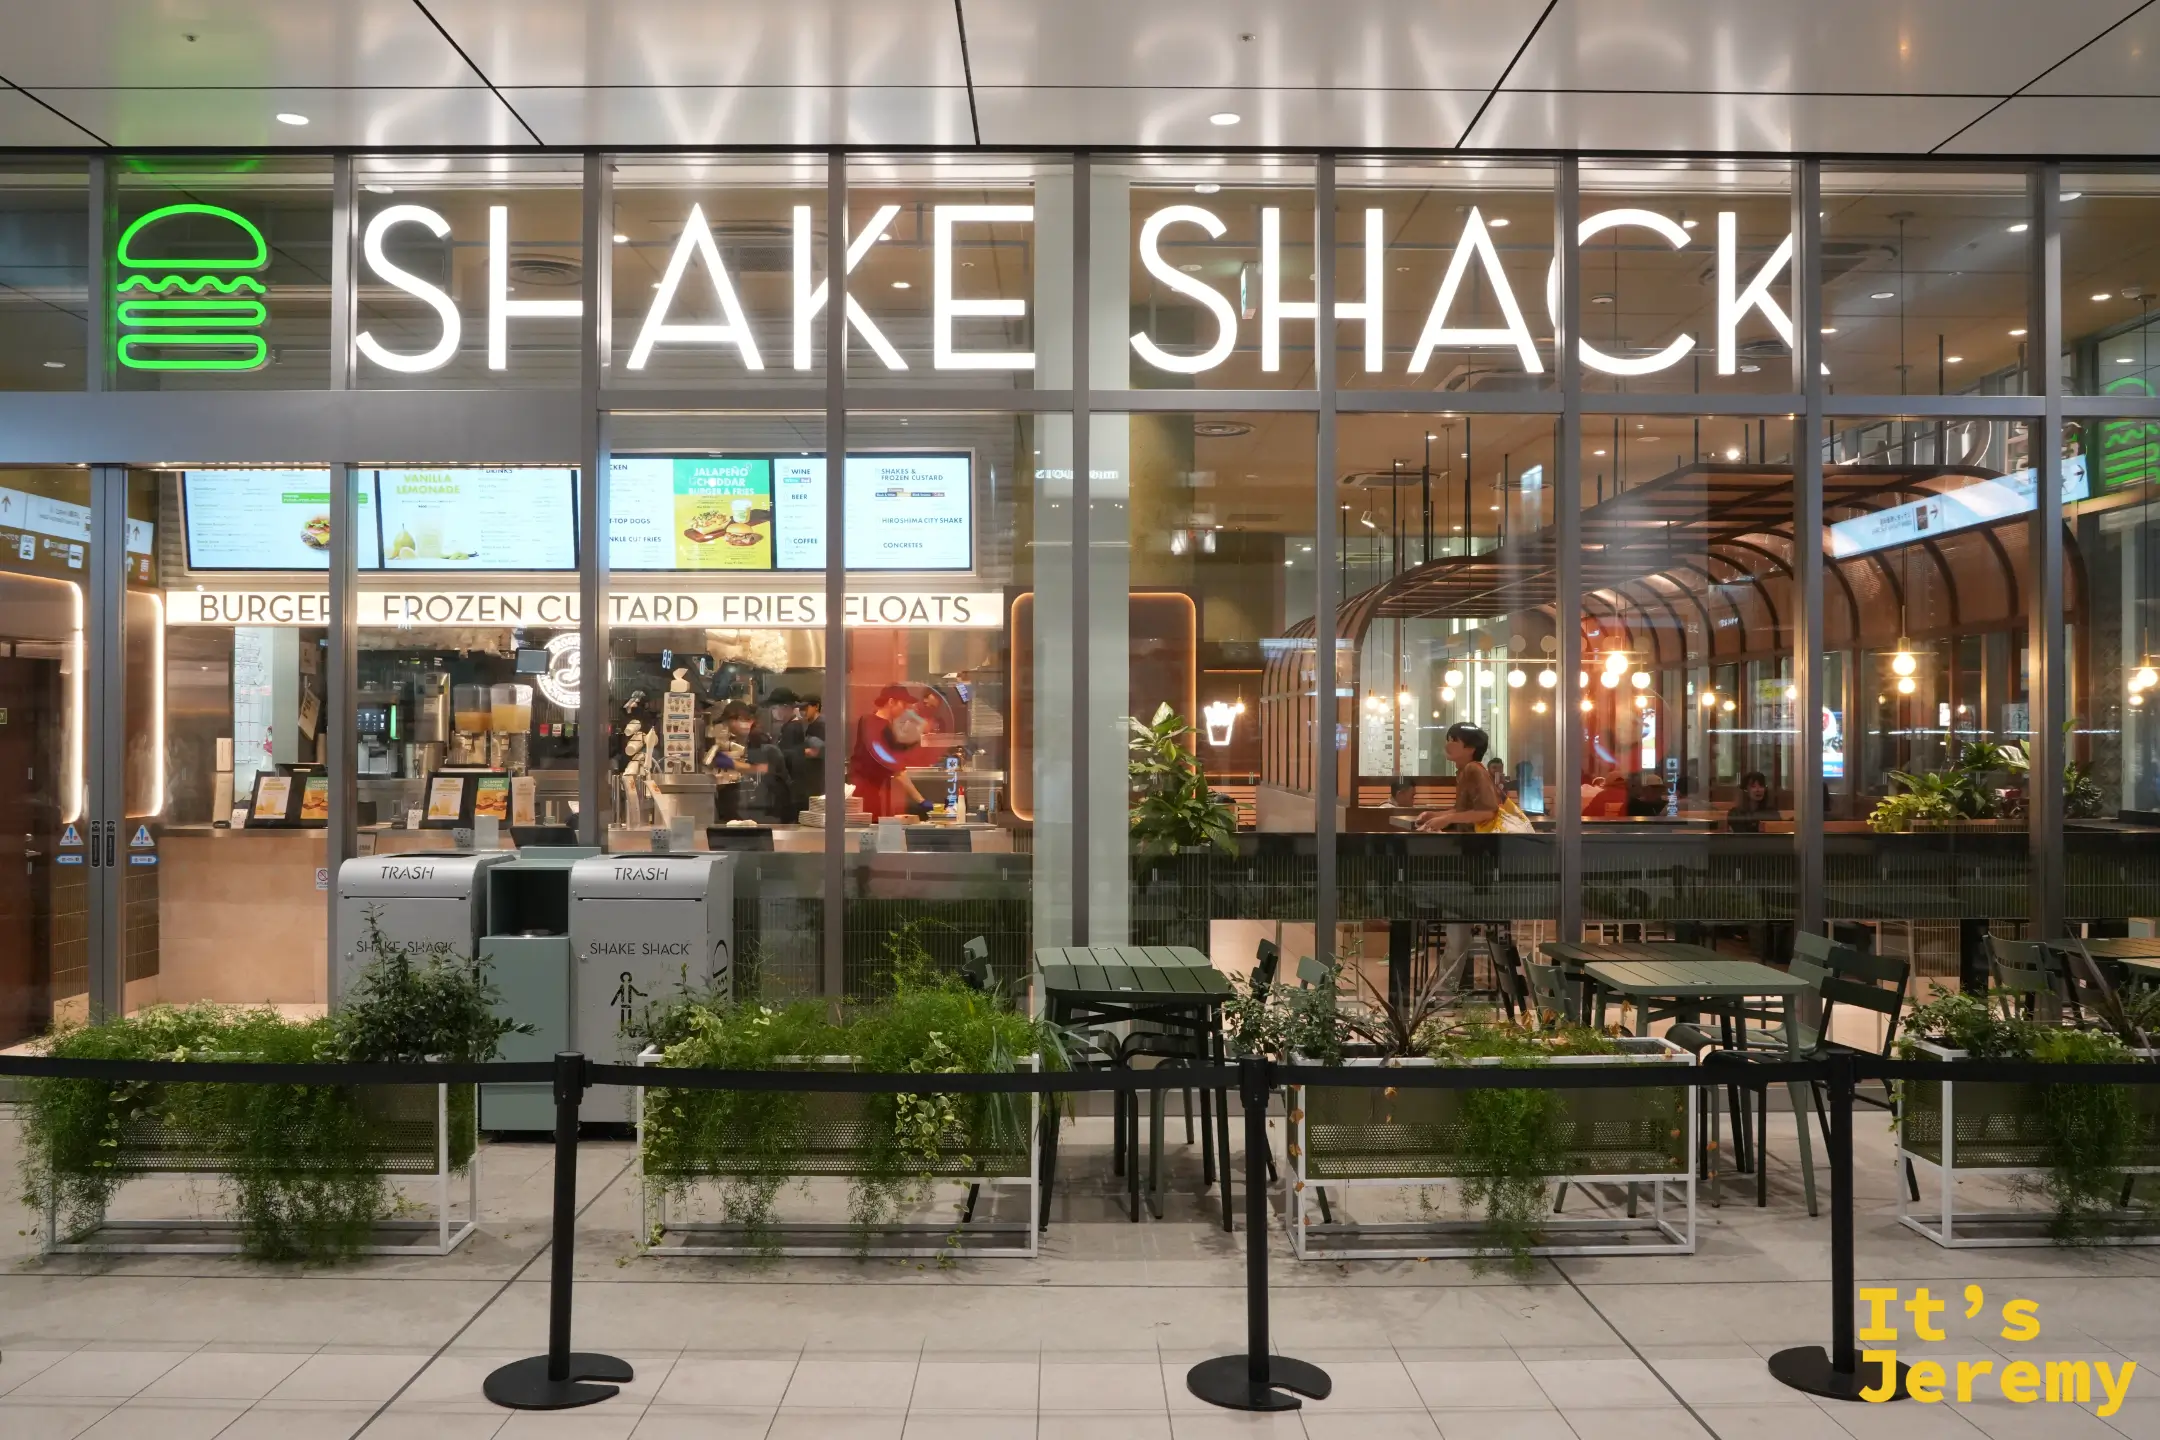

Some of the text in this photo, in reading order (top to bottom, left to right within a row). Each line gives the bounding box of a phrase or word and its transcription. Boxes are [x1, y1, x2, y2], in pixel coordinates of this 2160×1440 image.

[355, 203, 1830, 375] SHAKE SHACK
[403, 474, 452, 483] VANILLA
[697, 477, 746, 487] CHDDAR
[396, 485, 461, 495] LEMONADE
[383, 595, 523, 622] FROZEN
[537, 595, 699, 622] CUTARD
[722, 595, 816, 623] FRIES
[844, 596, 971, 623] FLOATS
[381, 866, 435, 880] TRASH
[614, 867, 669, 881] TRASH
[407, 941, 454, 953] SHACK
[590, 942, 690, 955] SHAKE SHACK
